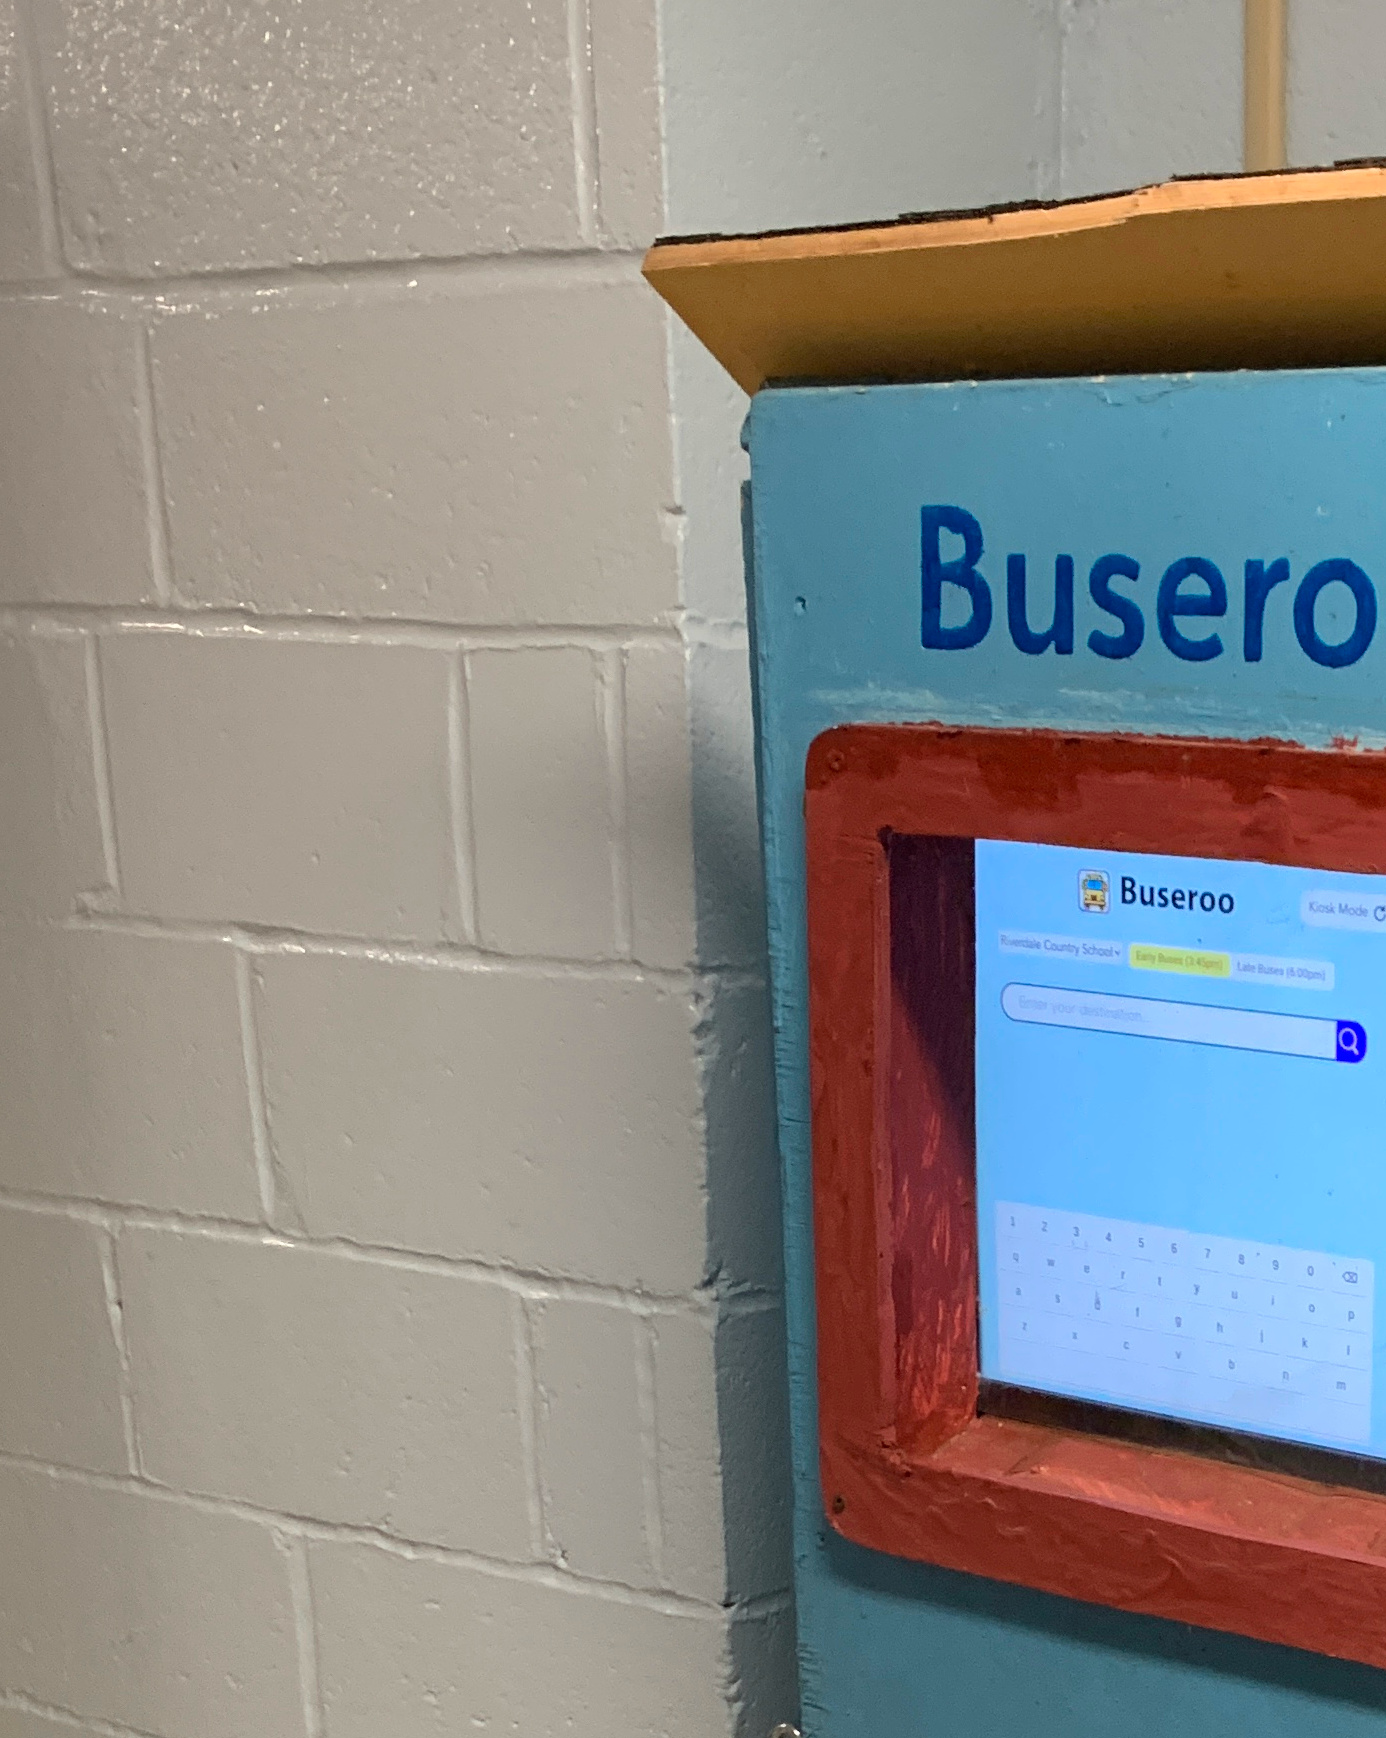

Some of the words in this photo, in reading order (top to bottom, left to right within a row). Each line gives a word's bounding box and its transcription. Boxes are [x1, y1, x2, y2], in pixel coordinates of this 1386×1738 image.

[1120, 876, 1235, 915] Buseroo
[1308, 901, 1335, 914] Kiosk
[1338, 902, 1368, 917] Mode
[1000, 934, 1042, 950] Riverdale
[1043, 939, 1079, 956] Country
[1082, 943, 1114, 958] School
[1136, 950, 1156, 964] Early
[1158, 953, 1183, 967] Buses
[1237, 960, 1256, 973] Late
[1258, 963, 1284, 976] Buses
[1010, 1215, 1016, 1227] 1
[1041, 1220, 1048, 1233] 2
[1073, 1226, 1080, 1237] 3
[1105, 1232, 1112, 1242] 4
[1138, 1237, 1145, 1248] 5
[1170, 1242, 1178, 1254] 6
[1204, 1247, 1211, 1259] 7
[1238, 1253, 1245, 1265] 8
[1271, 1259, 1280, 1271] 9
[1083, 1264, 1091, 1274] e
[1193, 1283, 1201, 1296] y
[1231, 1290, 1239, 1300] u
[1308, 1303, 1316, 1313] o
[1347, 1310, 1356, 1322] p
[1015, 1287, 1022, 1296] a
[1055, 1293, 1061, 1304] s
[1174, 1316, 1183, 1328] g
[1216, 1321, 1224, 1333] h
[1301, 1337, 1309, 1348] k
[1123, 1341, 1130, 1350] c
[1175, 1350, 1182, 1359] v
[1228, 1358, 1236, 1370] b
[1282, 1370, 1290, 1381] n
[1335, 1381, 1347, 1391] m
